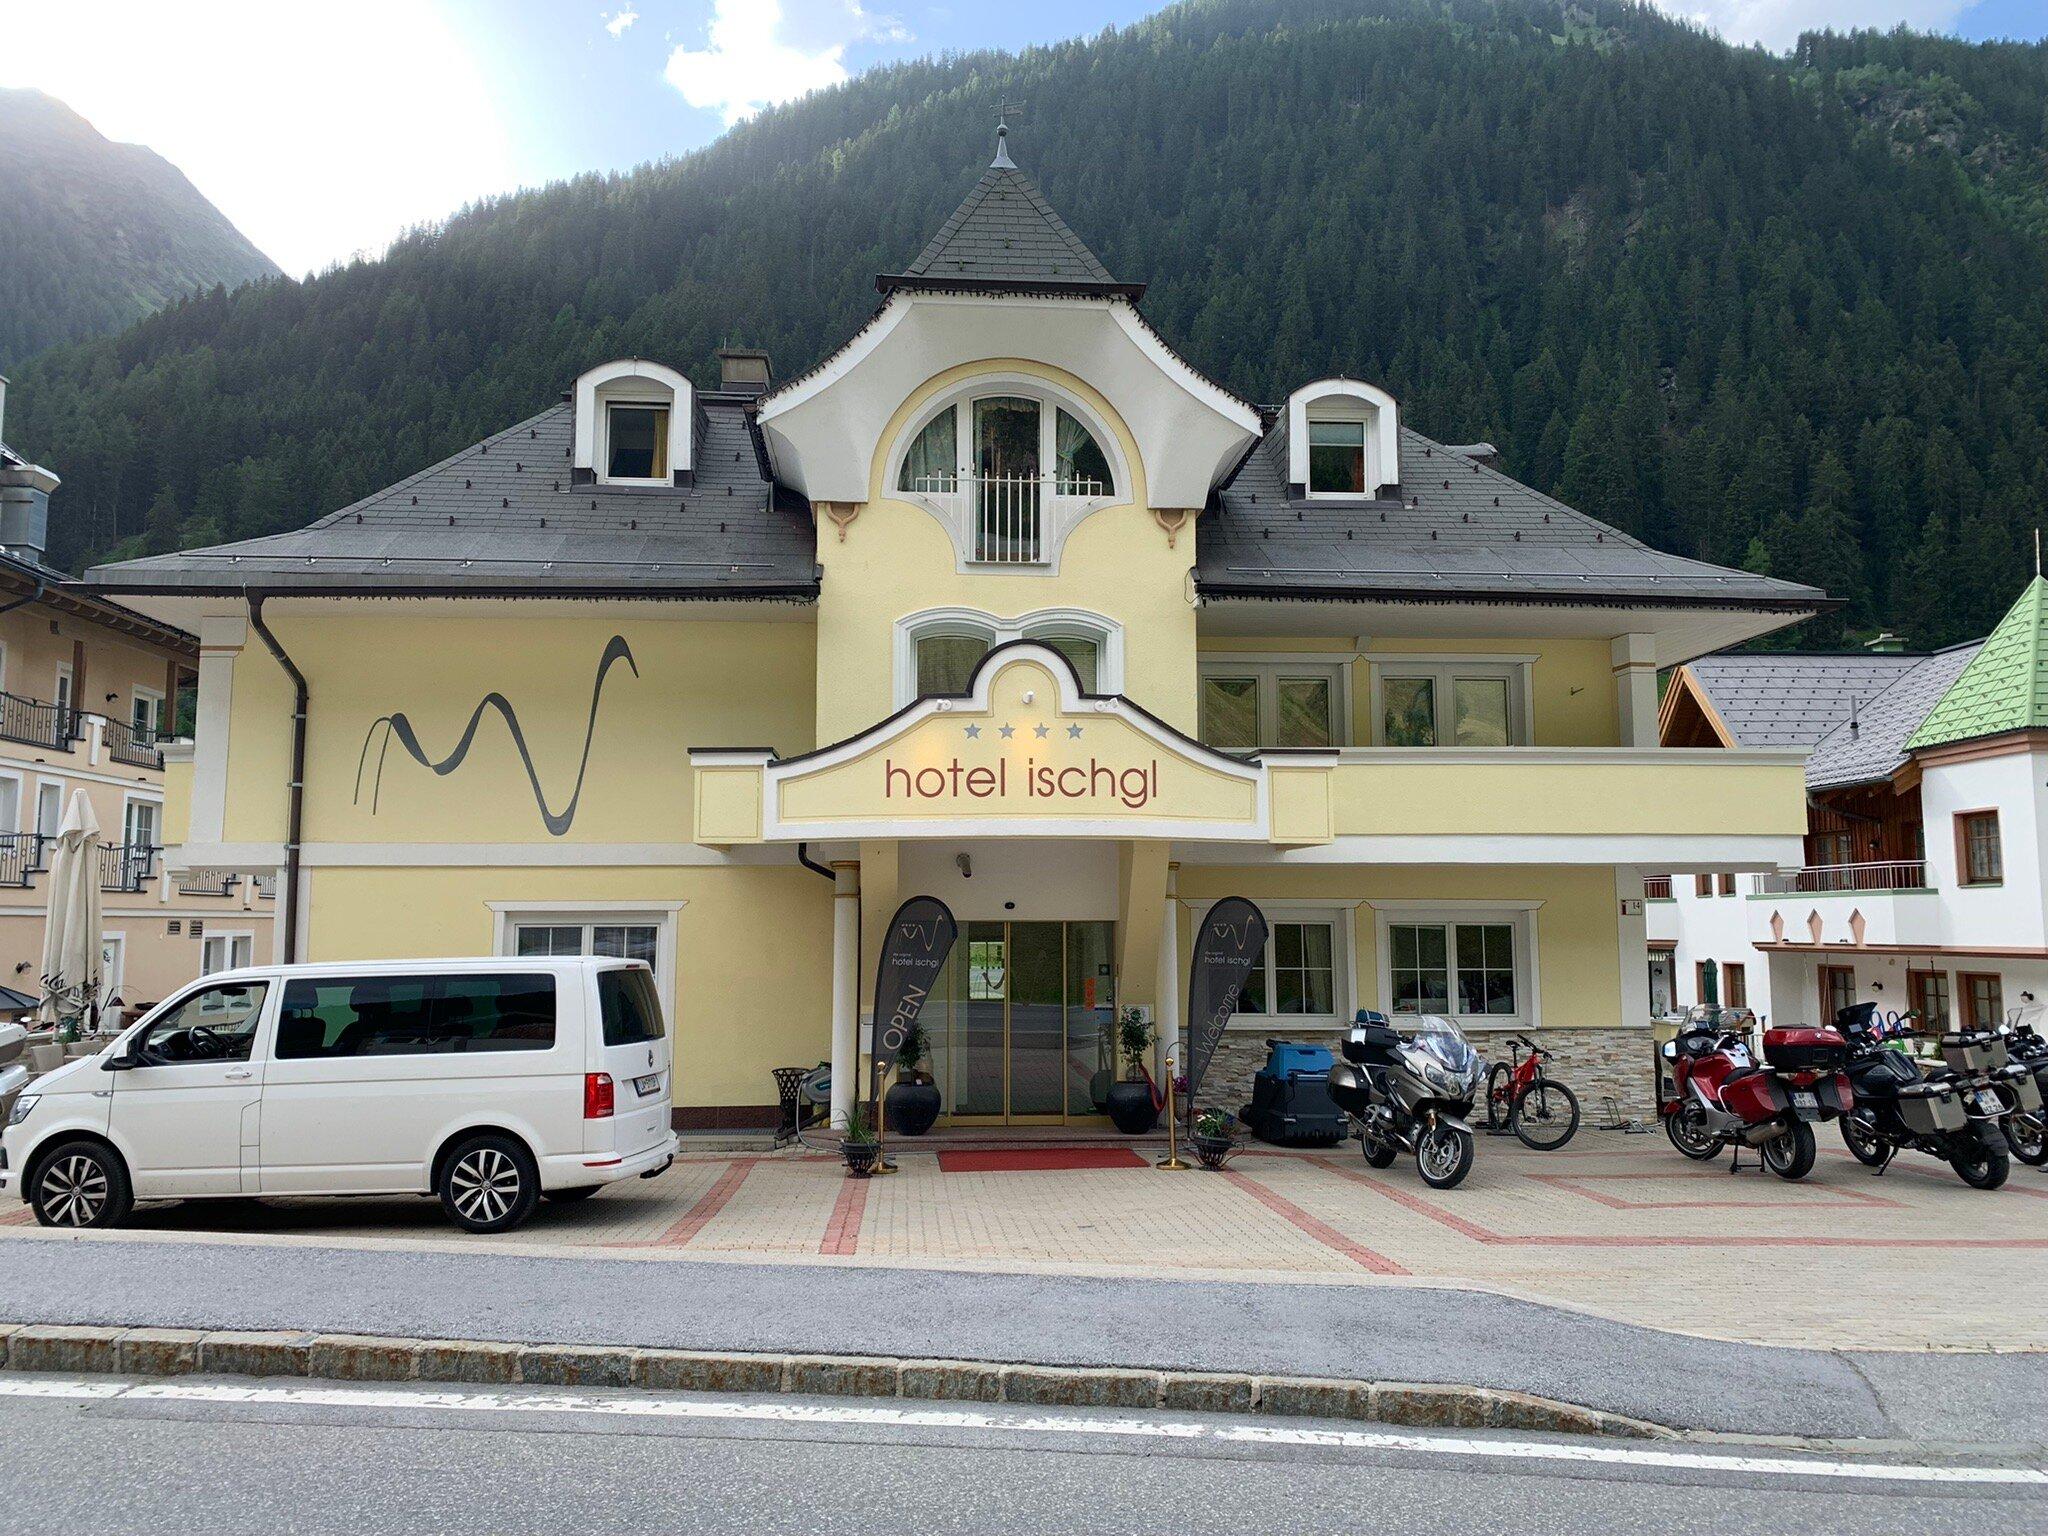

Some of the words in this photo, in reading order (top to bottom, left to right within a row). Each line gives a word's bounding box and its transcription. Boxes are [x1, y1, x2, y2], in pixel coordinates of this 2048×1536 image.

[886, 758, 1005, 798] hotel
[1028, 758, 1157, 808] ischgl
[892, 958, 913, 966] hotel
[915, 958, 940, 968] ischgl
[1204, 956, 1225, 964] hotel
[1227, 957, 1251, 967] ischgl
[883, 983, 926, 1050] OPEN
[1195, 984, 1240, 1055] Welcome
